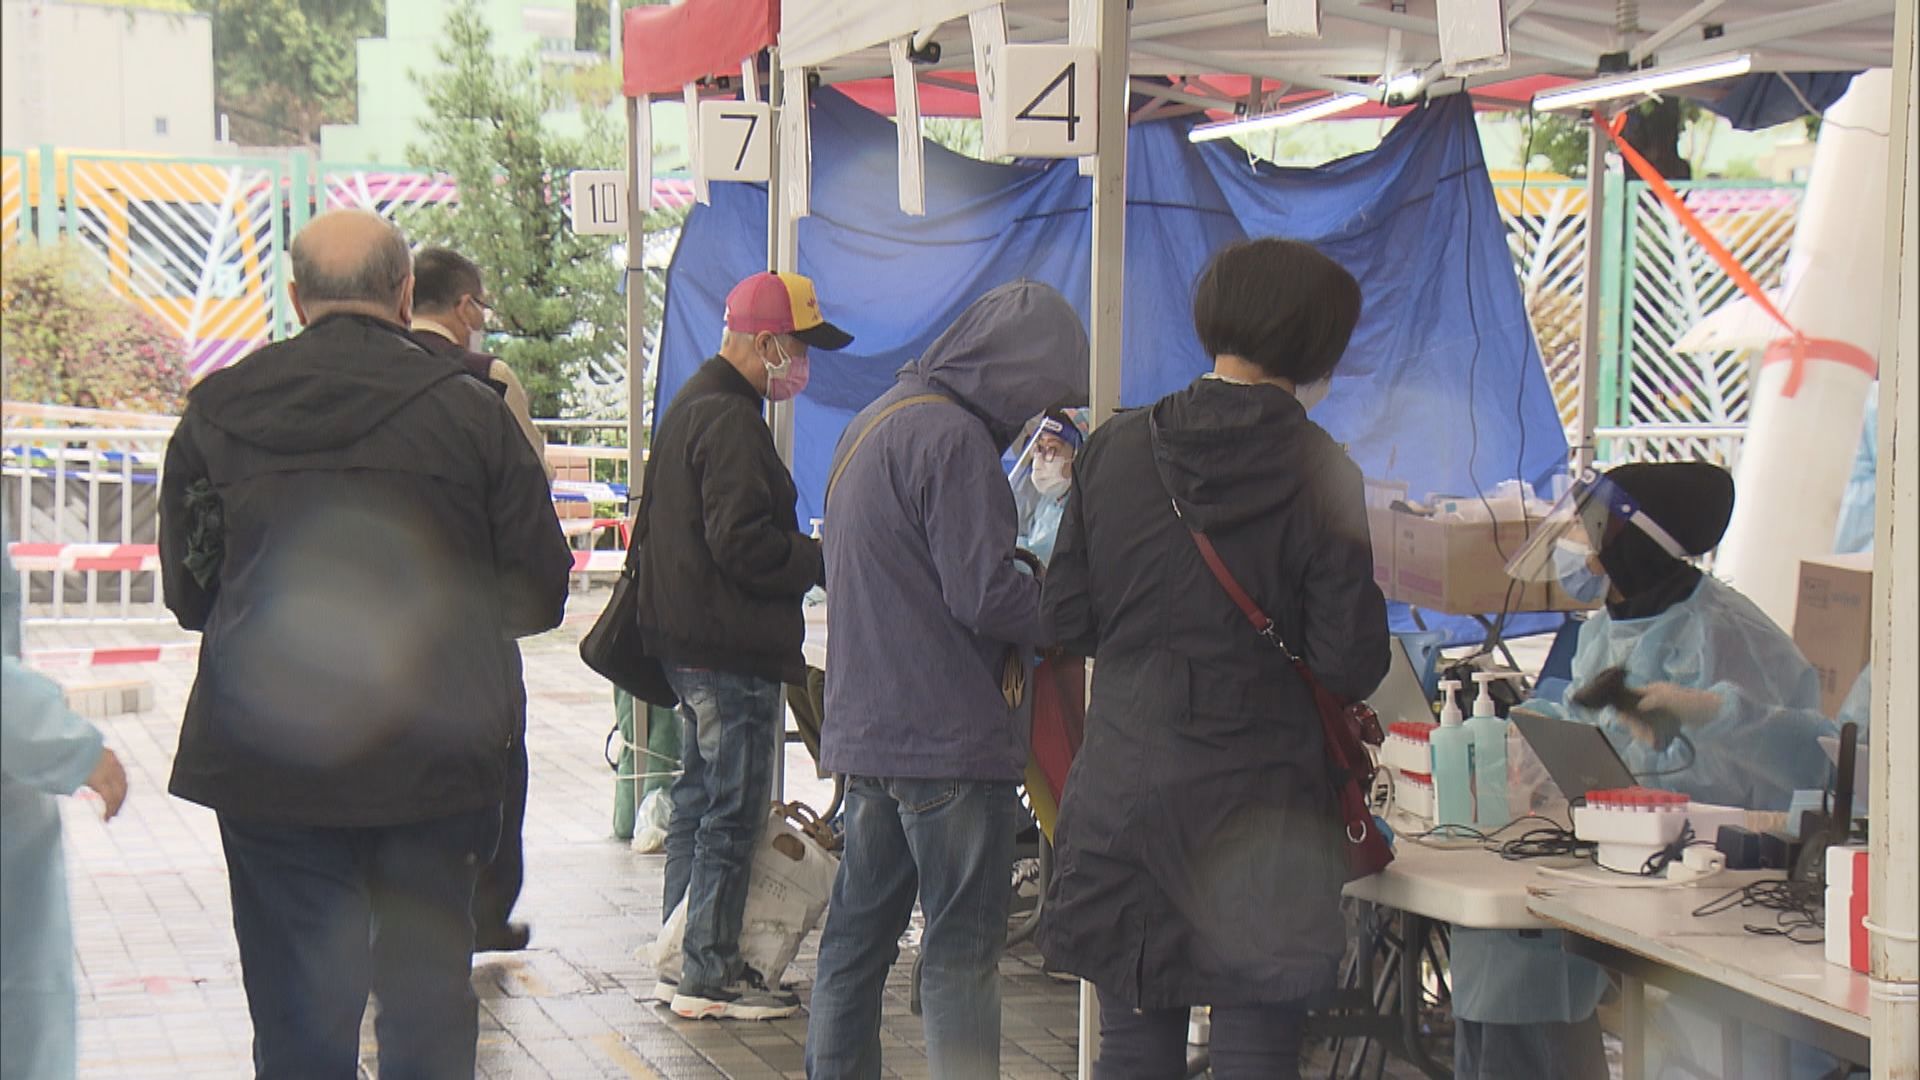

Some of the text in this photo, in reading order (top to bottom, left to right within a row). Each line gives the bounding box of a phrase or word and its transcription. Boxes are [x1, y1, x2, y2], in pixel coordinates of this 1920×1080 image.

[1015, 62, 1081, 141] 4
[720, 114, 758, 171] 7
[588, 183, 617, 223] 10
